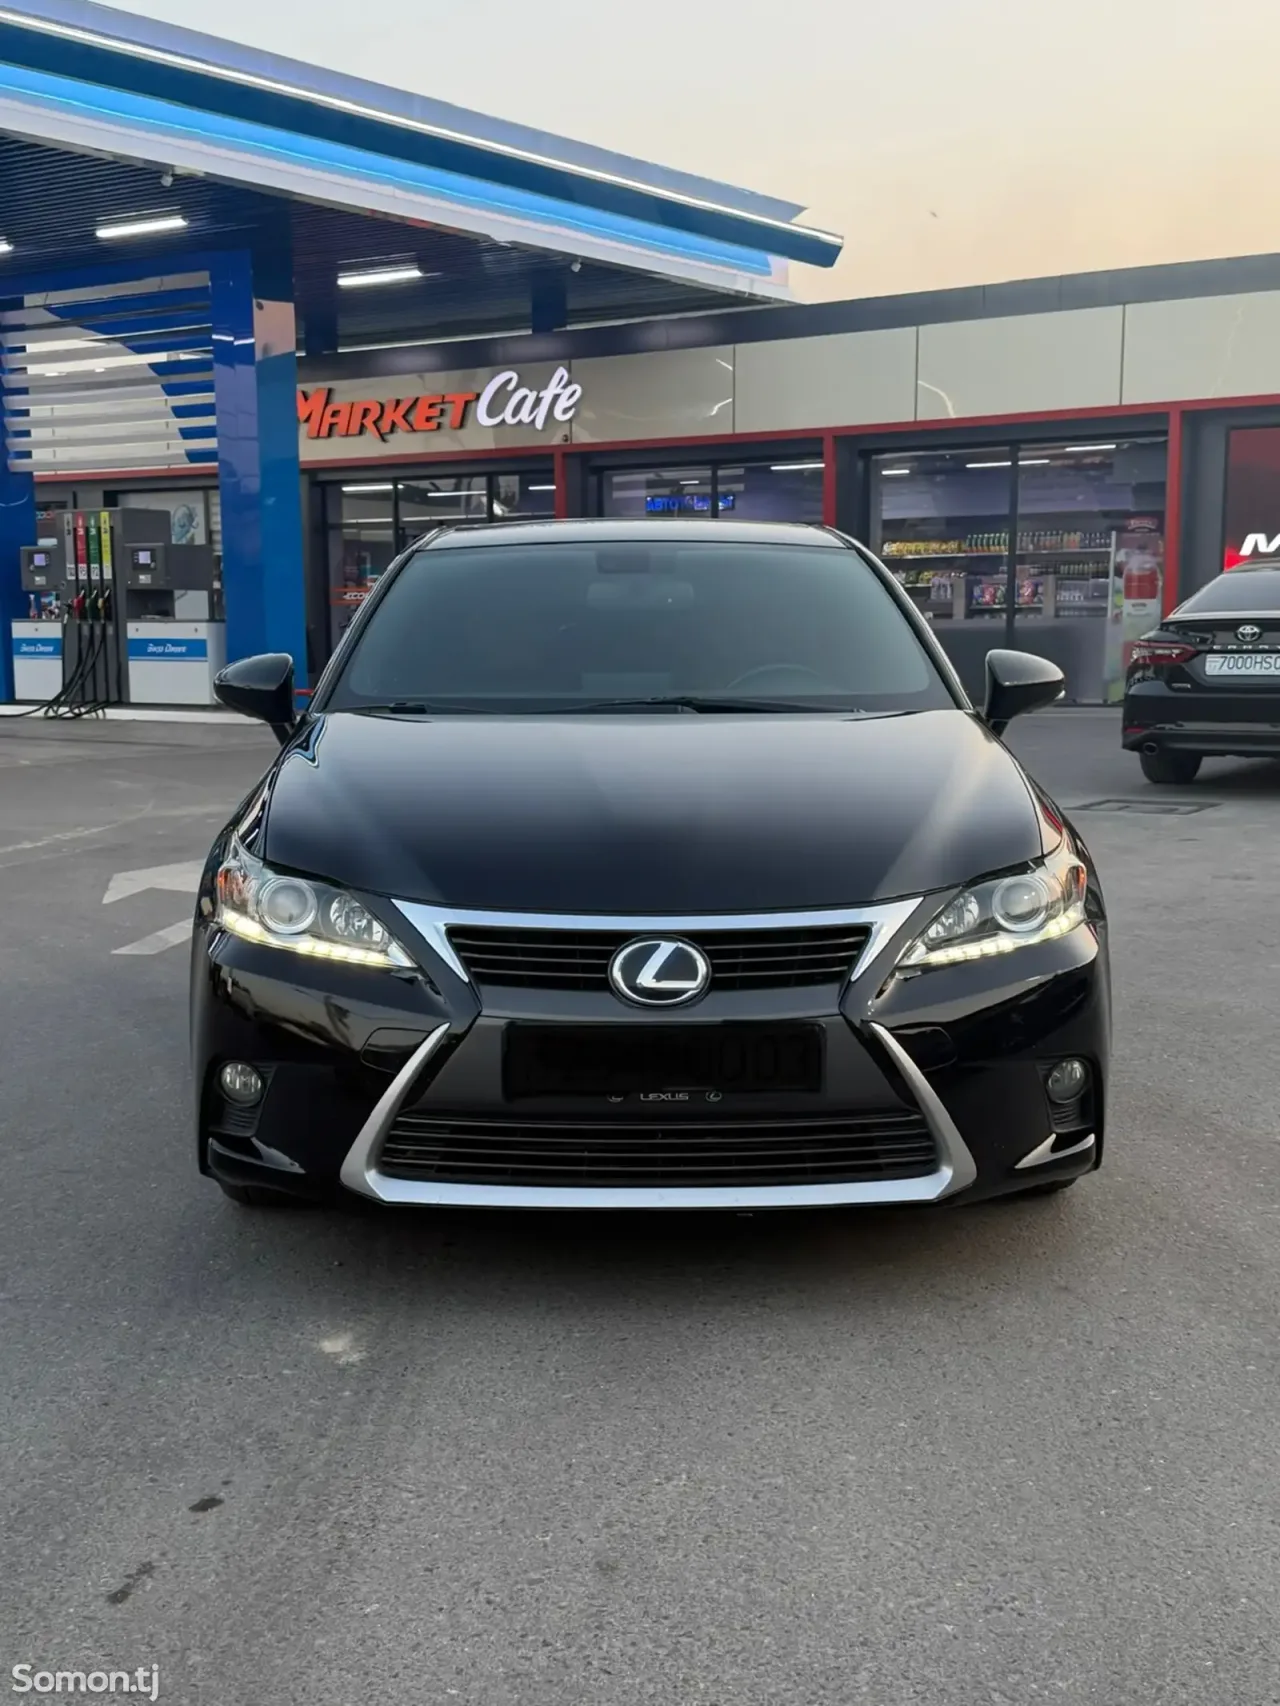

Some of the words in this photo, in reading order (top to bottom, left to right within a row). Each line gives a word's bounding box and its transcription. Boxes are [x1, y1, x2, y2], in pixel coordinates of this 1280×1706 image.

[296, 387, 477, 440] MARKET
[476, 366, 583, 431] Cafe
[640, 1092, 689, 1101] LEXUS
